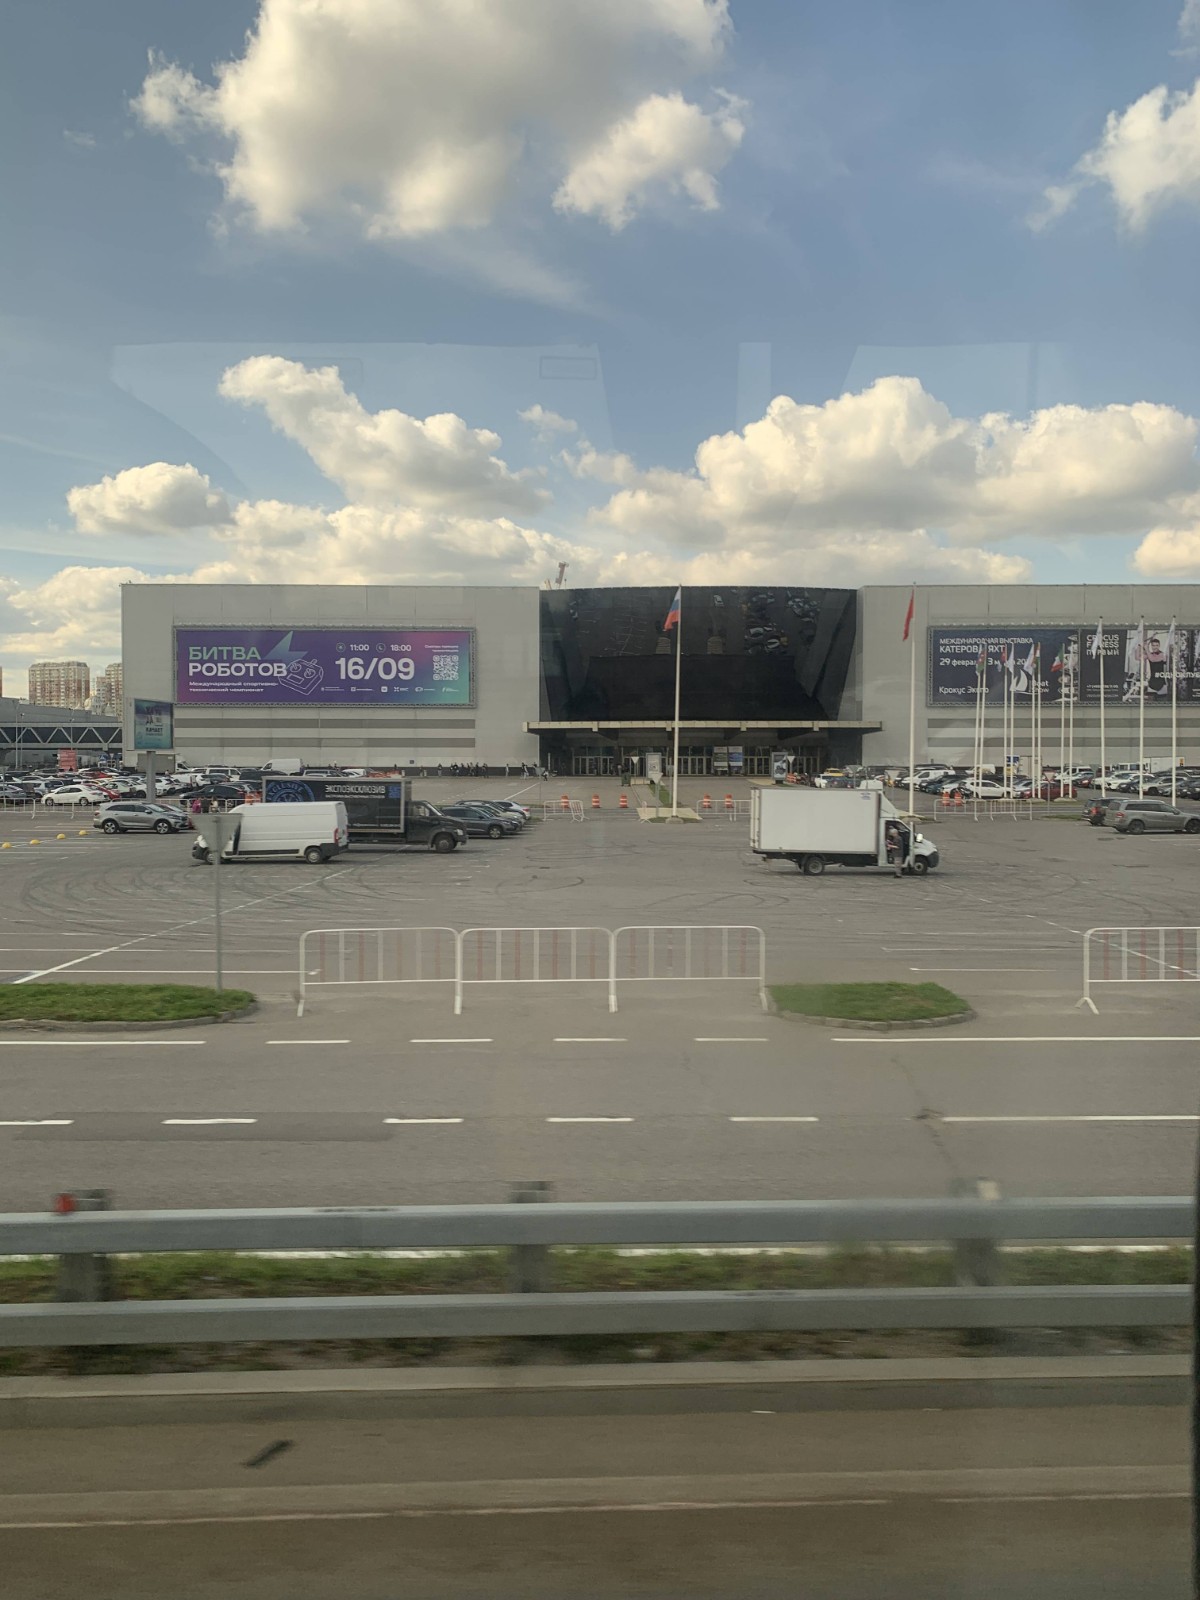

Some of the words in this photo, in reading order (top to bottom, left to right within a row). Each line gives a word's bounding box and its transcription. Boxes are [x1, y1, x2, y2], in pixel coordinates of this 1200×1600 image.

[188, 646, 262, 661] БИТВА
[939, 657, 951, 666] 29
[987, 657, 994, 666] 3
[188, 662, 288, 677] РОБОТОВ
[334, 657, 416, 680] 16/09
[939, 686, 966, 695] Крокус
[324, 785, 386, 794] ЭКСПОЭКСКЛЮЗИВ
